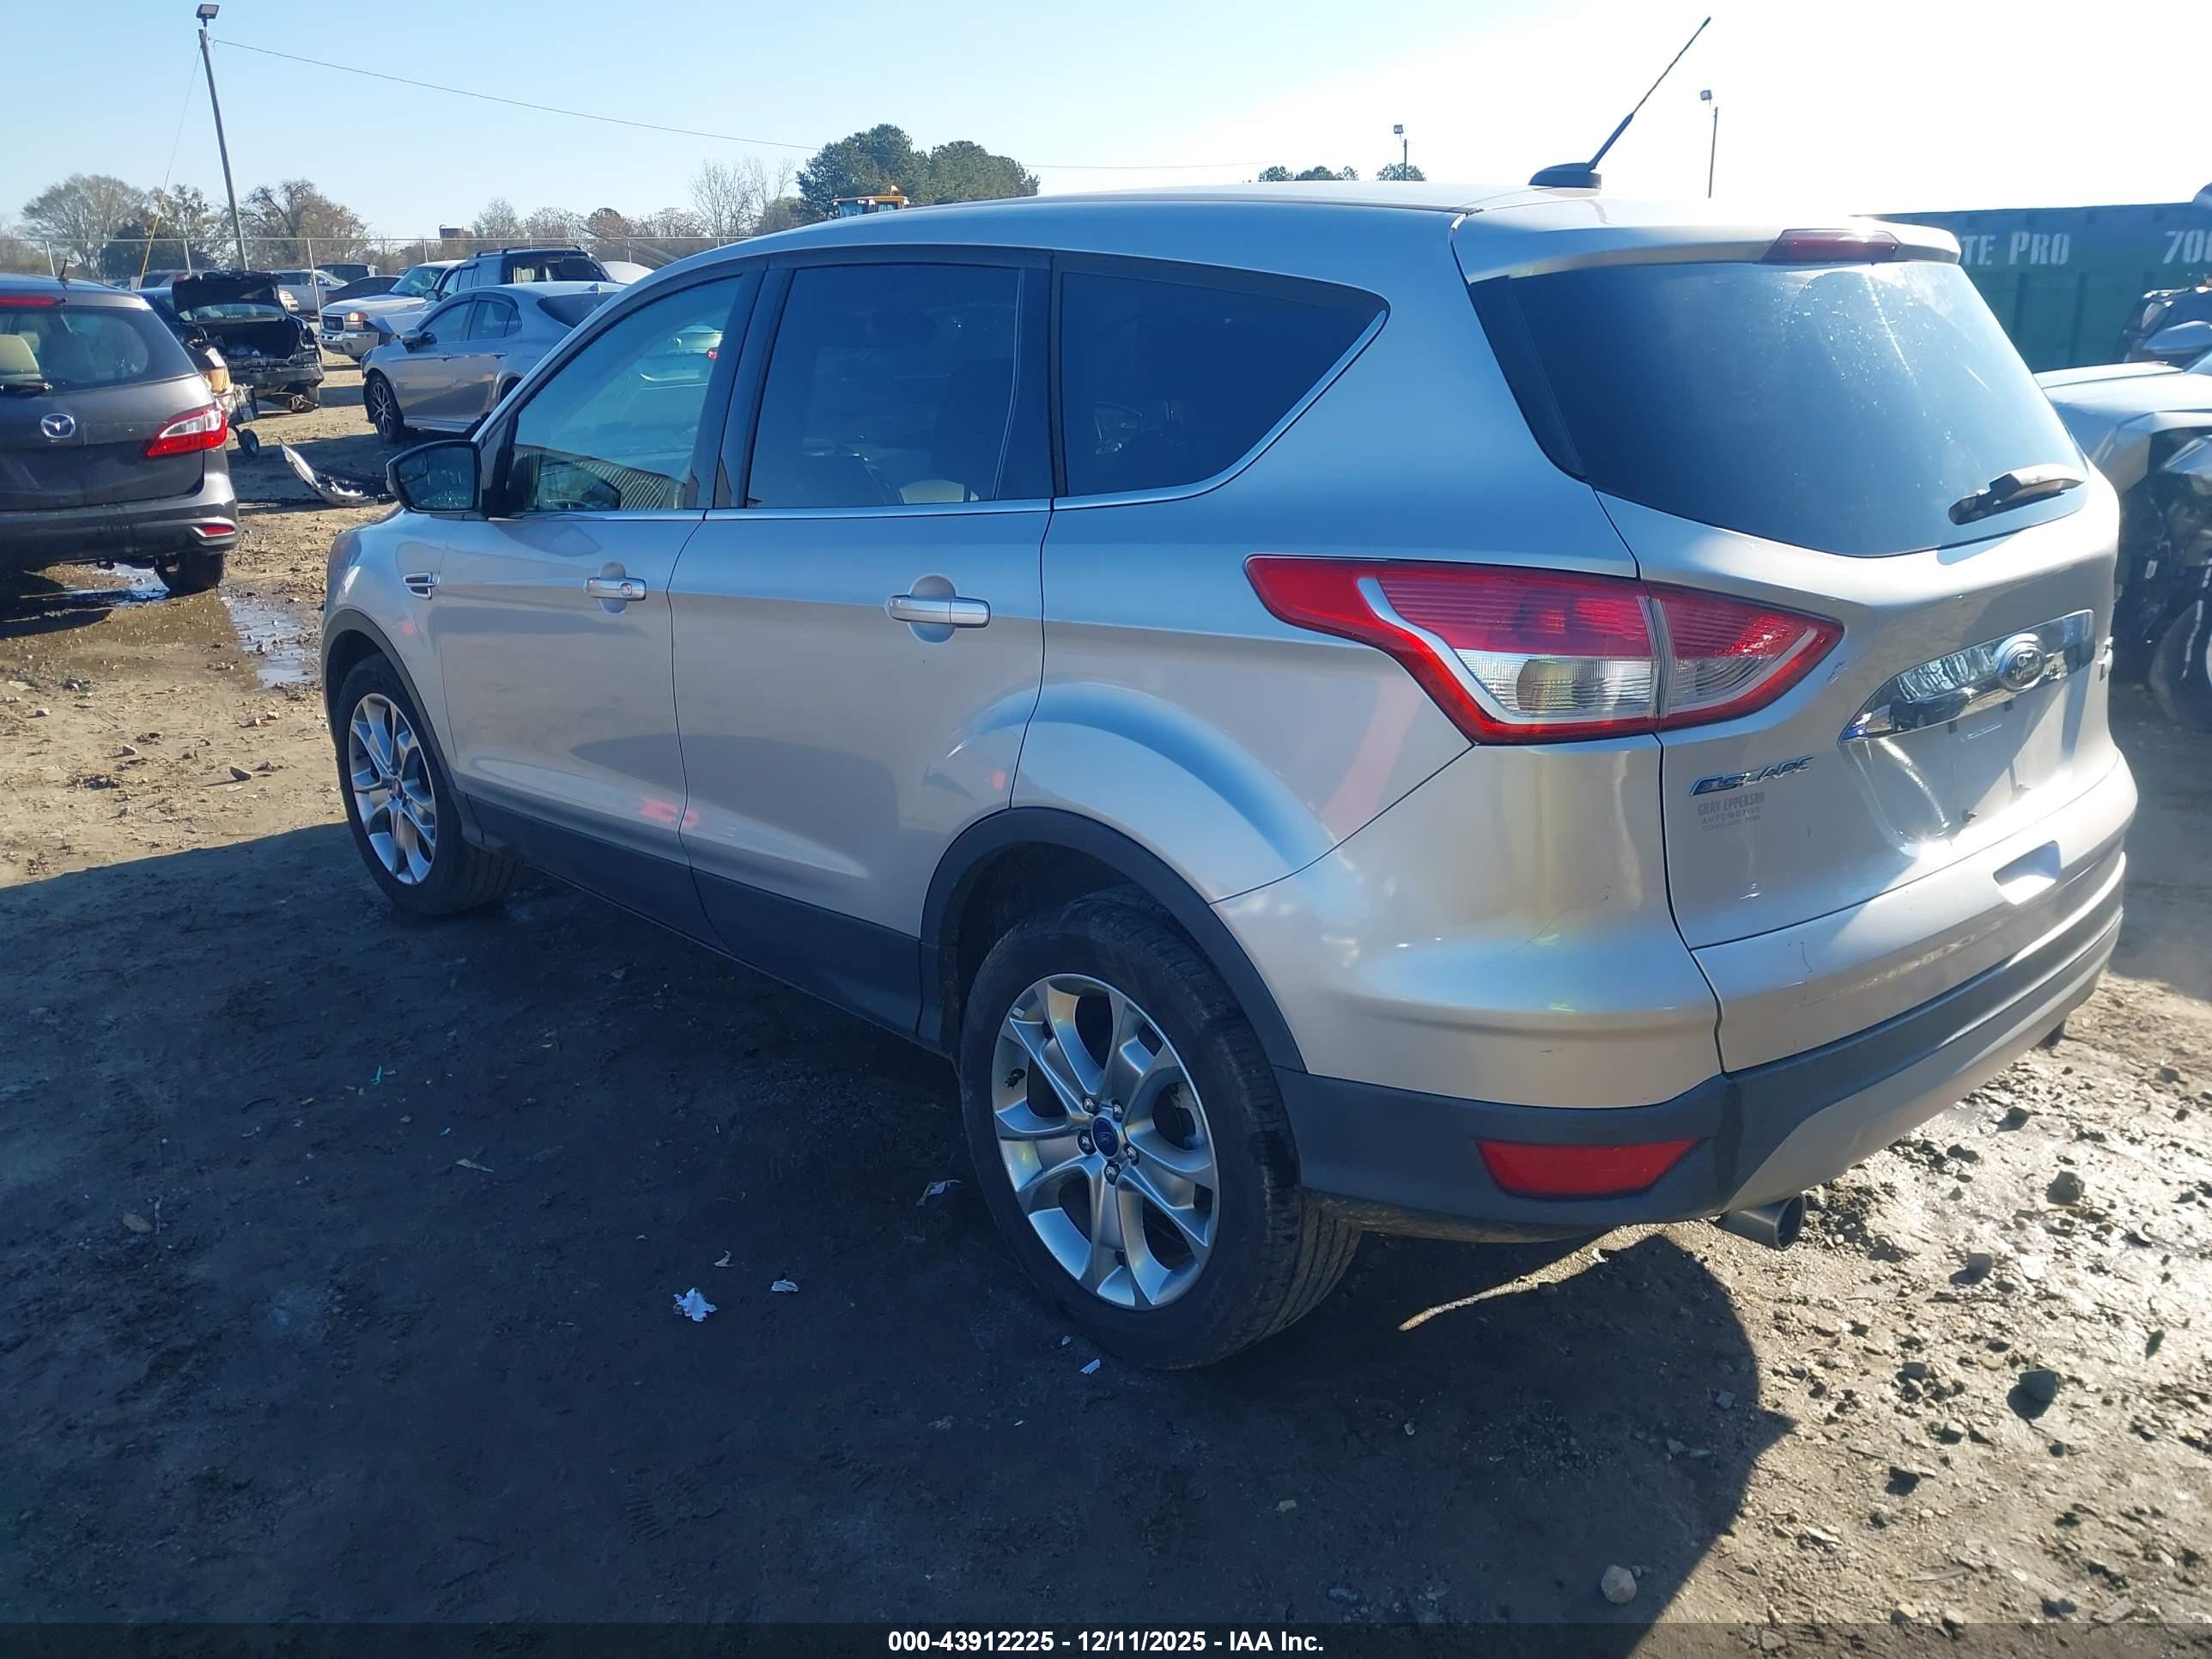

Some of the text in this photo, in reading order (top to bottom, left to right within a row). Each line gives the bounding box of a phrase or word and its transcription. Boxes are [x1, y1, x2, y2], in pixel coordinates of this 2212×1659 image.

[1961, 231, 2070, 265] TE PRO
[1689, 755, 1814, 797] ESCAPE
[1702, 805, 1761, 824] AUTOMOTIVE
